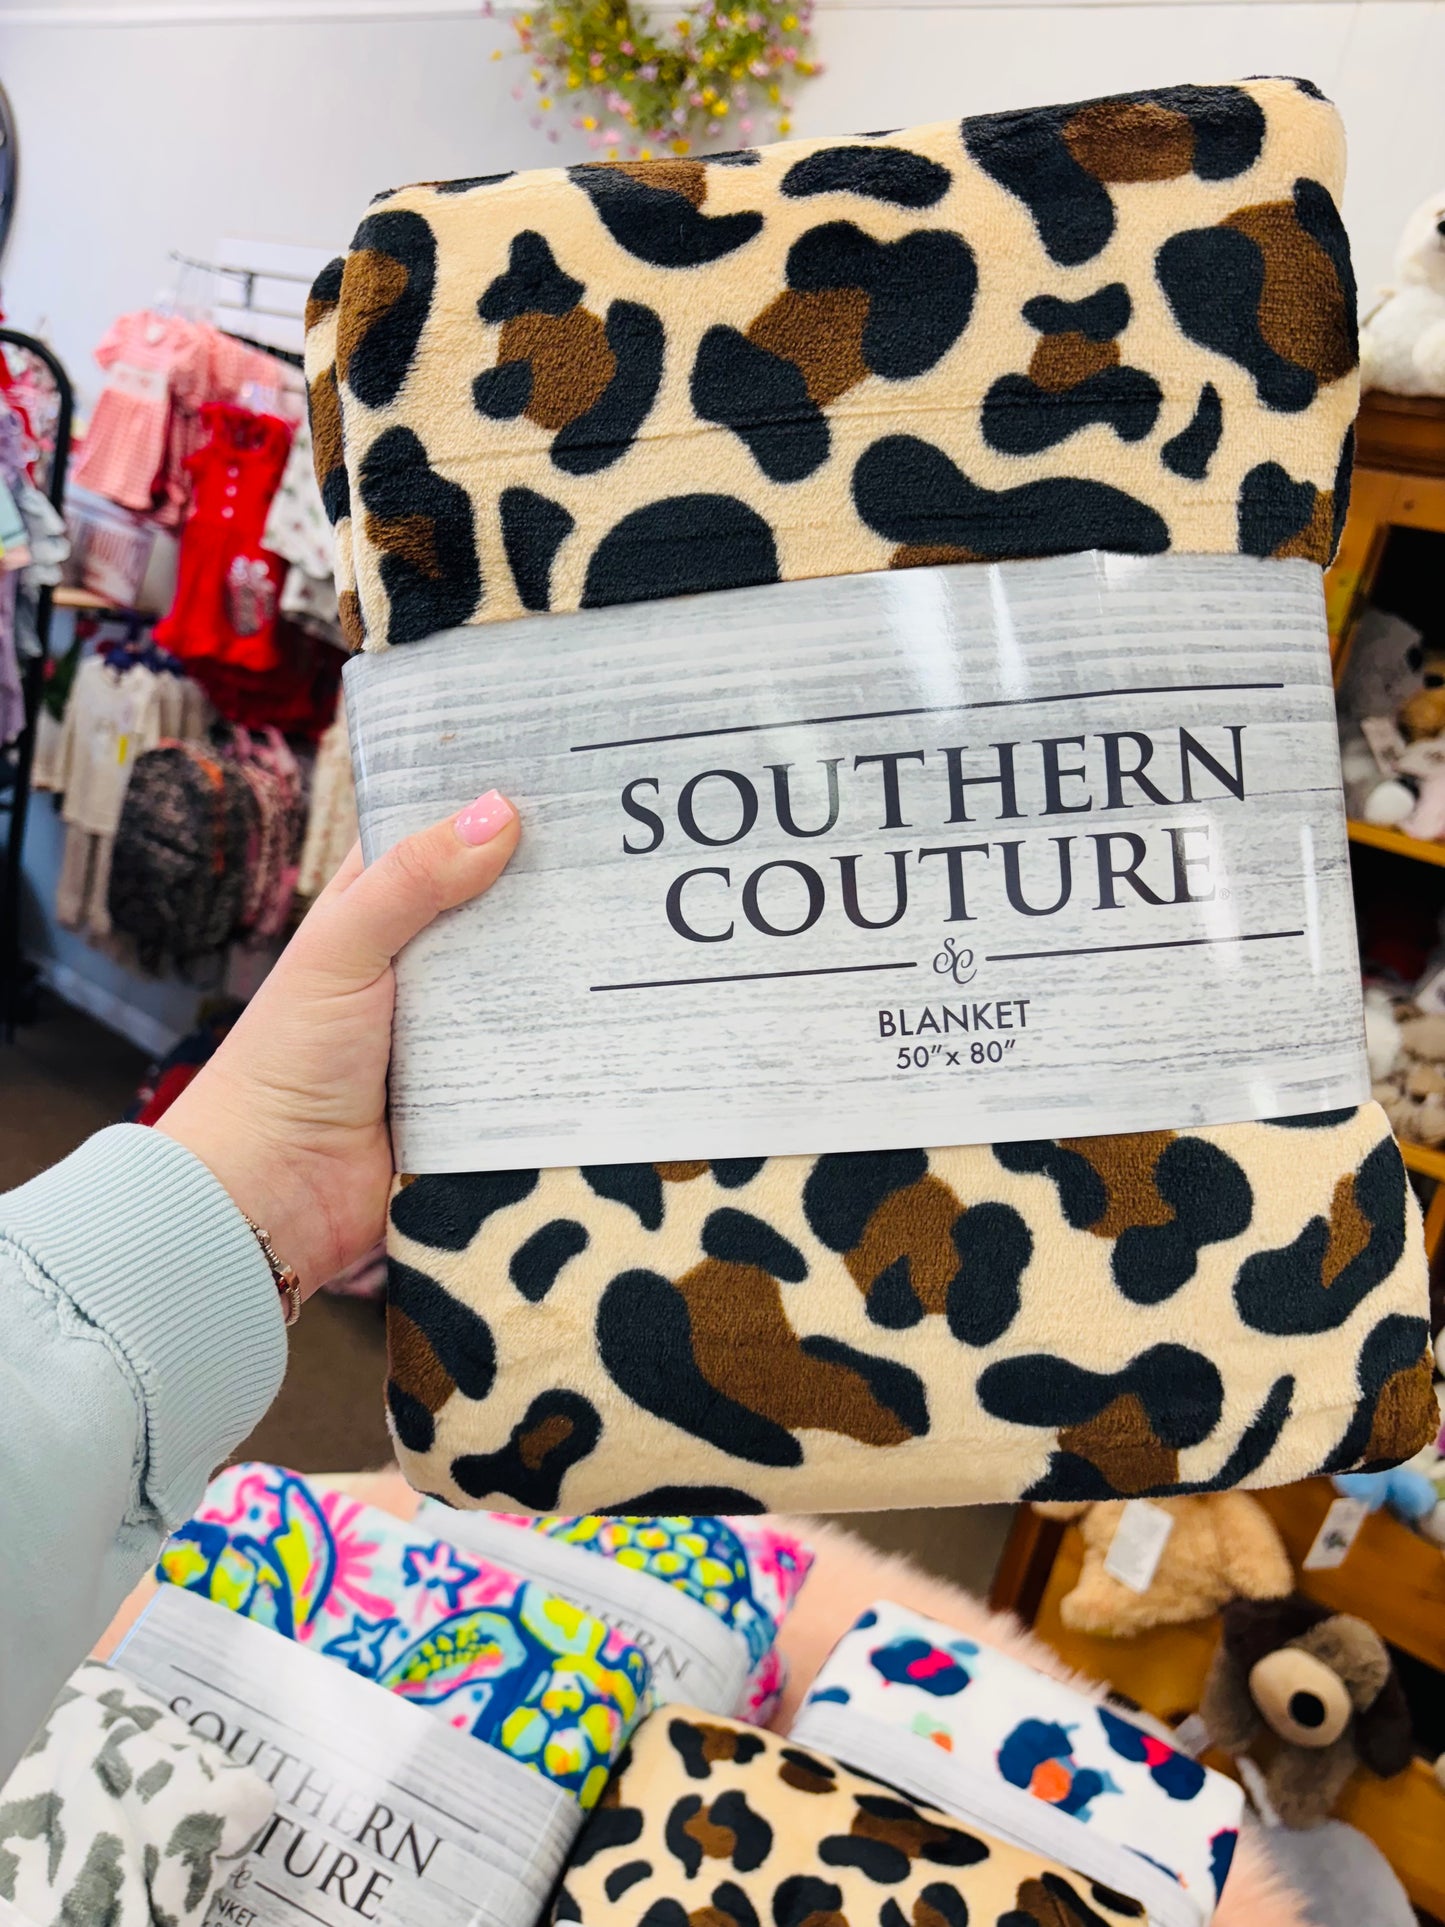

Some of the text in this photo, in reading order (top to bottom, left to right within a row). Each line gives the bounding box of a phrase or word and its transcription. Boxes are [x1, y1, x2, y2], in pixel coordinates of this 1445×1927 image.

[621, 725, 1248, 855] SOUTHERN
[665, 825, 1216, 944] COUTURE
[878, 999, 1031, 1038] BLANKET
